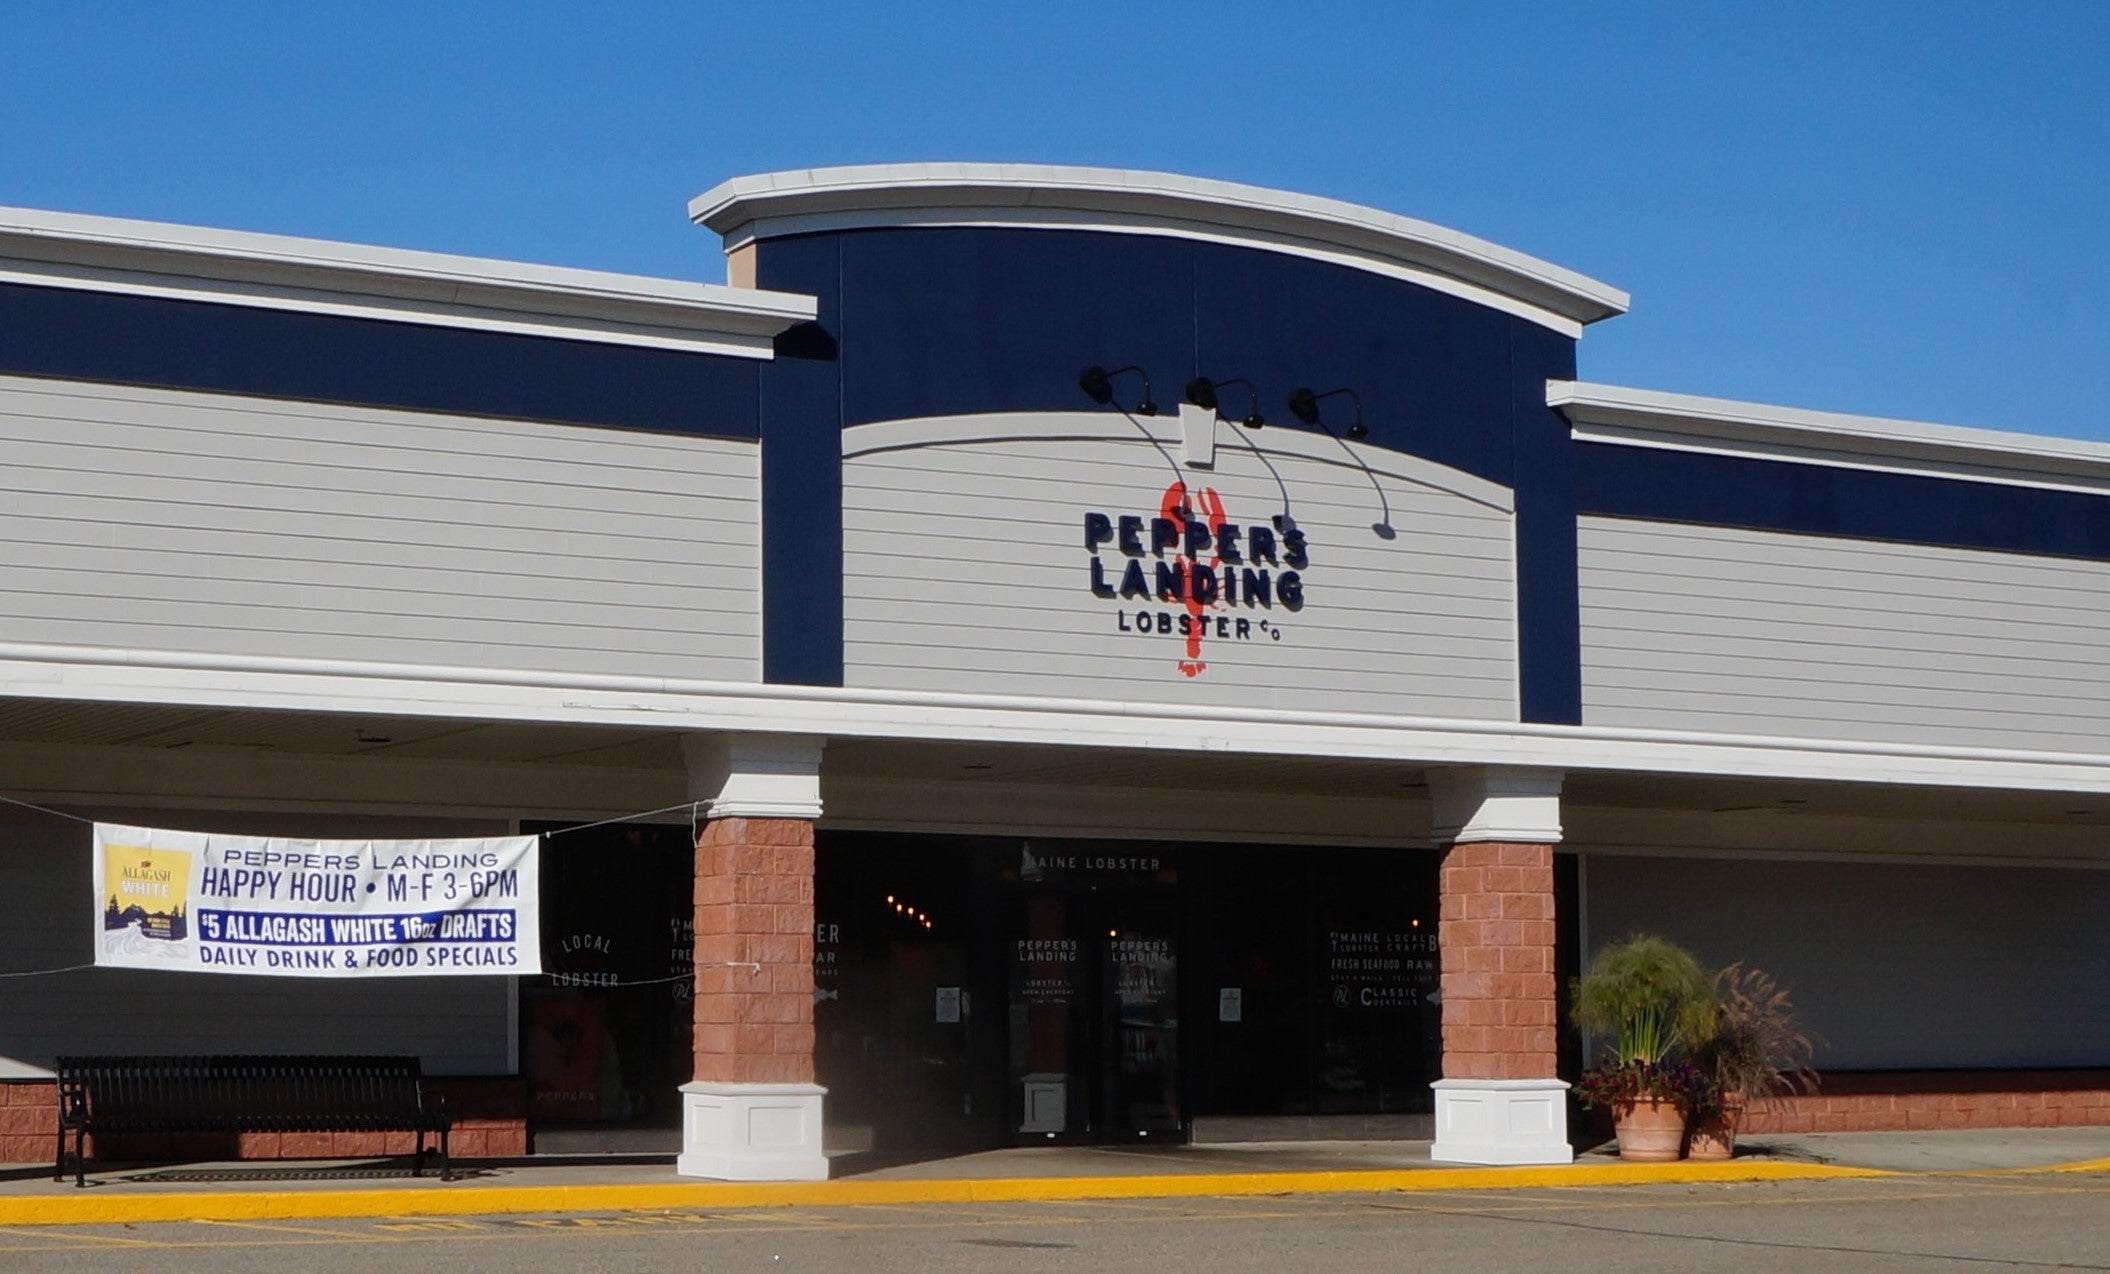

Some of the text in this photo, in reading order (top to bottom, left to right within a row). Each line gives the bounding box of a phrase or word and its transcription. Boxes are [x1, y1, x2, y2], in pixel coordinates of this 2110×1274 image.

[1085, 512, 1308, 570] PEPPER'S
[1091, 556, 1304, 611] LANDING
[1118, 610, 1250, 639] LOBSTER
[224, 850, 498, 870] PEPPERS LANDING
[1086, 857, 1160, 870] LOBSTER
[122, 866, 171, 882] ALLAGASH
[123, 880, 170, 898] WHITE
[201, 866, 518, 902] HAPPY HOUR M-F 3-6PM
[202, 913, 220, 939] $5
[225, 915, 326, 943] ALLAGASH
[331, 918, 397, 943] WHITE
[440, 913, 512, 939] DRAFTS
[816, 923, 840, 944] ER
[561, 933, 612, 955] LOCAL
[1340, 932, 1426, 943] MAINE LOCAL
[200, 946, 517, 969] DAILY DRINK & FOOD SPECIALS
[671, 948, 692, 961] FRE
[815, 951, 836, 964] AR
[1019, 951, 1076, 962] LANDING
[1112, 951, 1168, 963] LANDING
[1331, 958, 1433, 970] FRESH SEAFOOD RAW
[552, 972, 619, 988] LOBSTER
